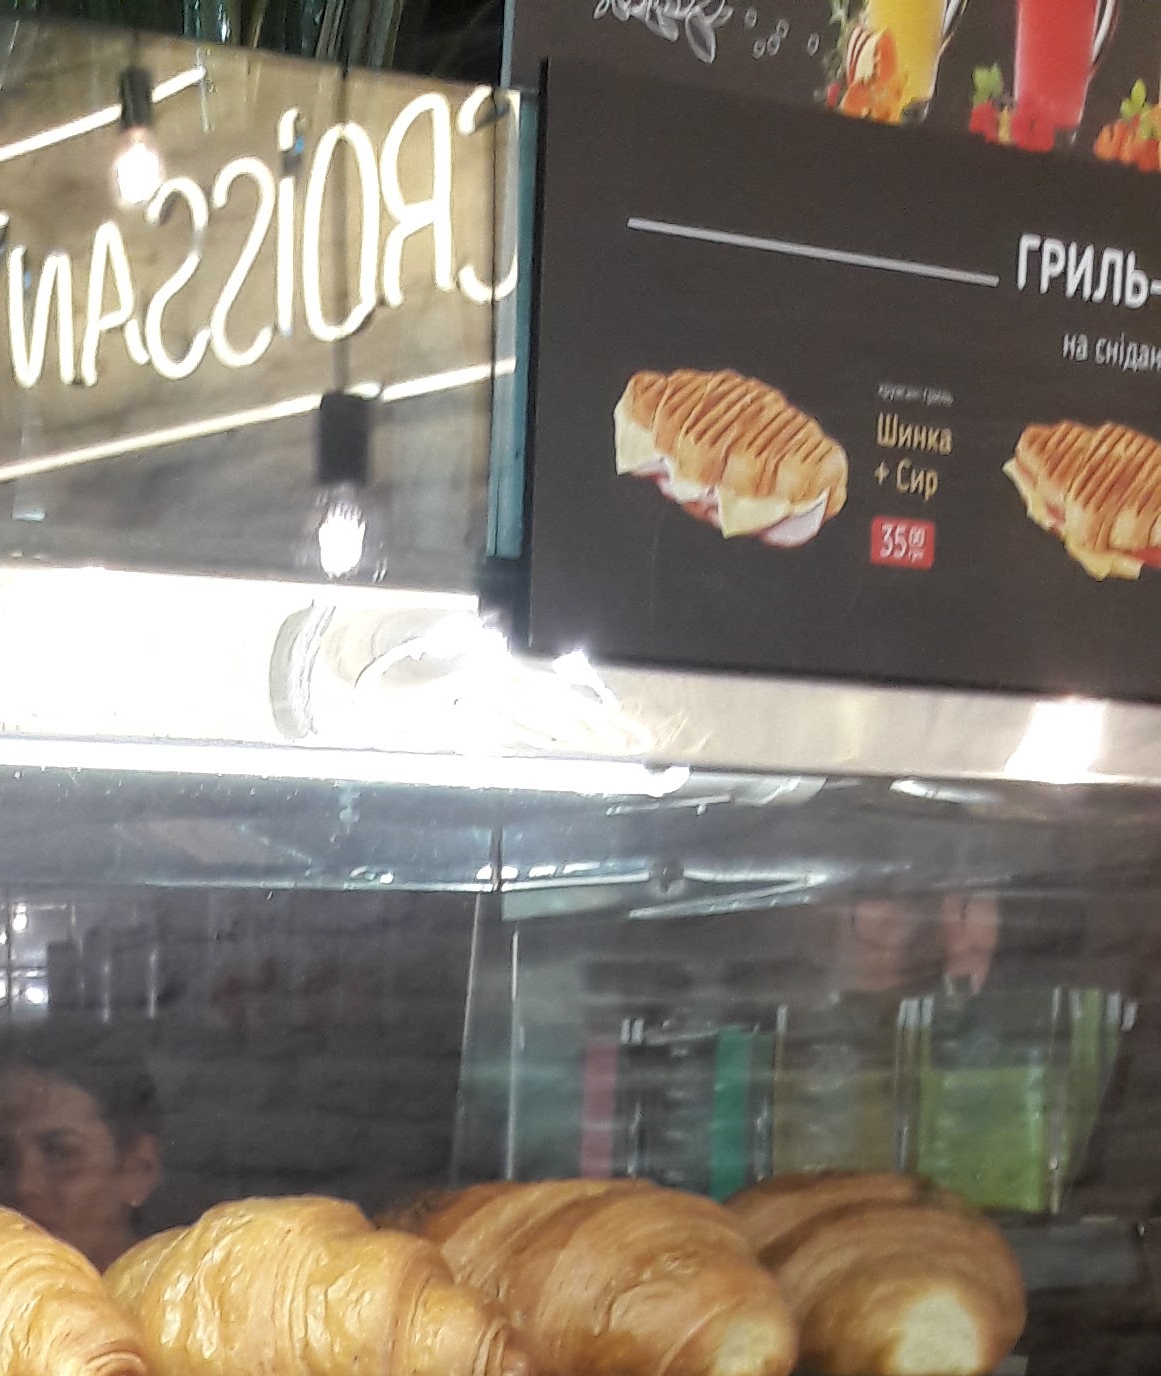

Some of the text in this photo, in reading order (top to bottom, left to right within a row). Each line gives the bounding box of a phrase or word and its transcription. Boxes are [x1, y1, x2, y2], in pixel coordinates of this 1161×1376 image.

[1062, 333, 1088, 362] на
[877, 411, 953, 456] Шинка
[896, 457, 940, 502] Сир
